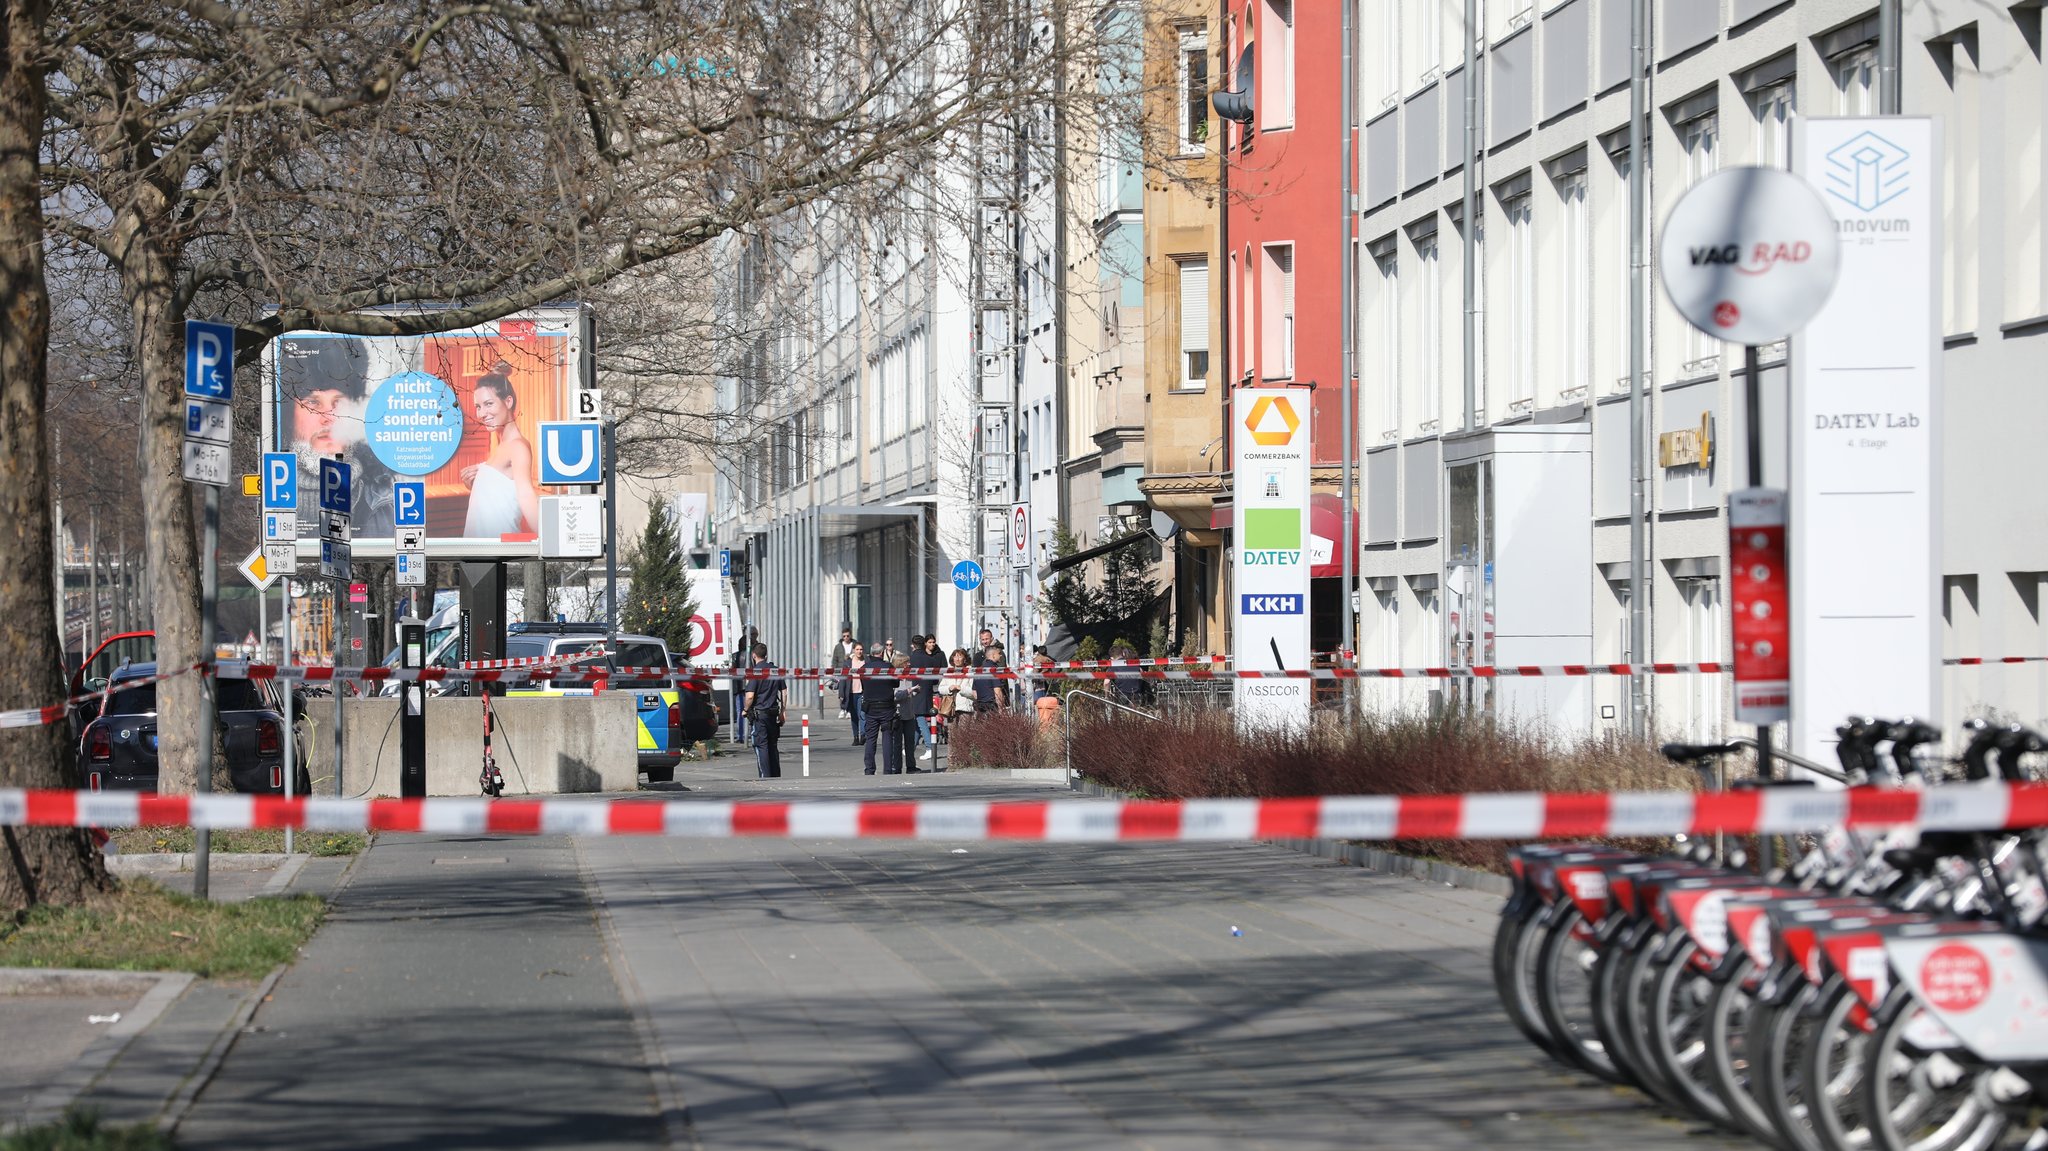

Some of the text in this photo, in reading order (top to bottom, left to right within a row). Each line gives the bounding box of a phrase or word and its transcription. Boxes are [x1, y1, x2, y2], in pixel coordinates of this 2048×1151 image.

[1833, 219, 1910, 233] nnovum
[1689, 240, 1812, 266] VAG RAD
[196, 331, 222, 386] P
[395, 379, 432, 394] nicht
[580, 393, 594, 414] B
[383, 411, 443, 426] sondern
[1815, 412, 1920, 429] DATEV Lab
[375, 428, 453, 442] saunieren!
[1860, 438, 1888, 450] Etage
[193, 447, 220, 463] Mo-Fr
[547, 430, 594, 477] U
[271, 460, 289, 502] P
[325, 466, 342, 503] P
[399, 487, 416, 521] P
[1017, 519, 1024, 539] 30
[271, 549, 290, 558] Mo-Fr
[1016, 553, 1026, 564] ZONE
[1244, 551, 1300, 565] DATEV
[721, 554, 728, 574] P
[1250, 597, 1295, 612] KKH
[1247, 685, 1300, 696] ASSECOR
